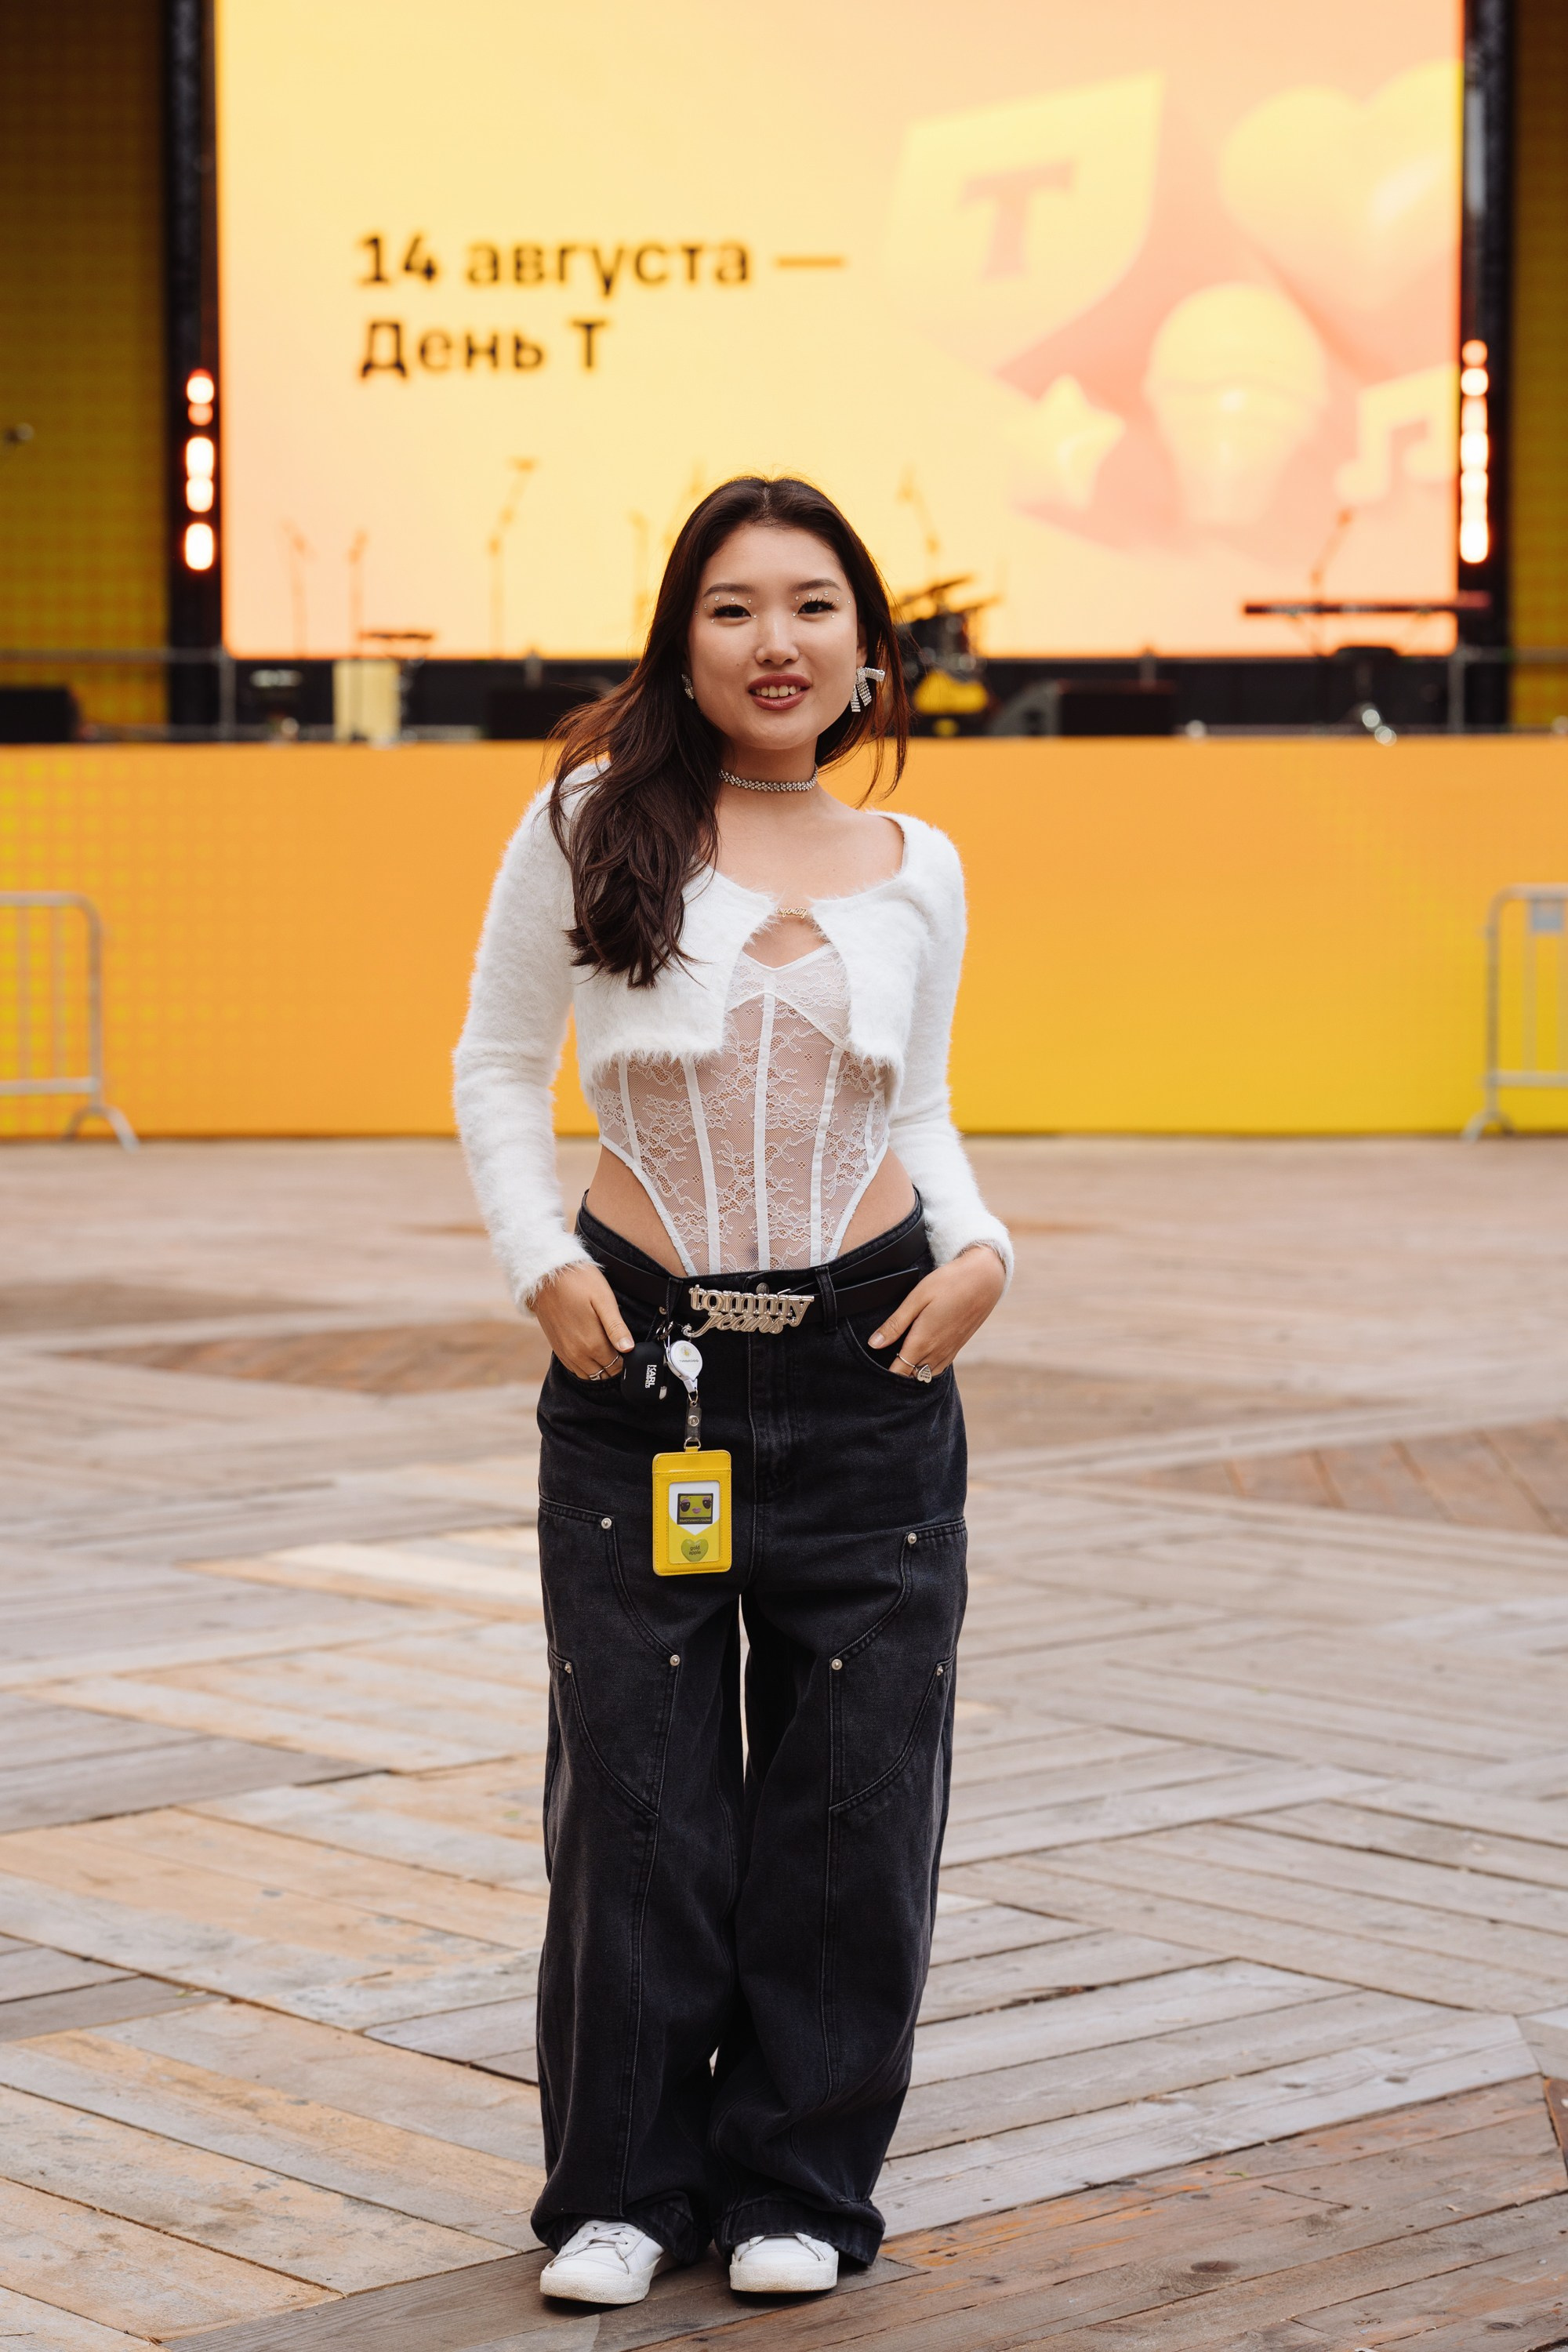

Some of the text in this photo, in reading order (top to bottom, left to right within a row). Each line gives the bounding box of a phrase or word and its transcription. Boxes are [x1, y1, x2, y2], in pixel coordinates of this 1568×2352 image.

[356, 234, 437, 287] 14
[466, 241, 750, 298] августа
[360, 318, 608, 380] День Т
[688, 1283, 815, 1327] tommy
[648, 1364, 658, 1385] KARL
